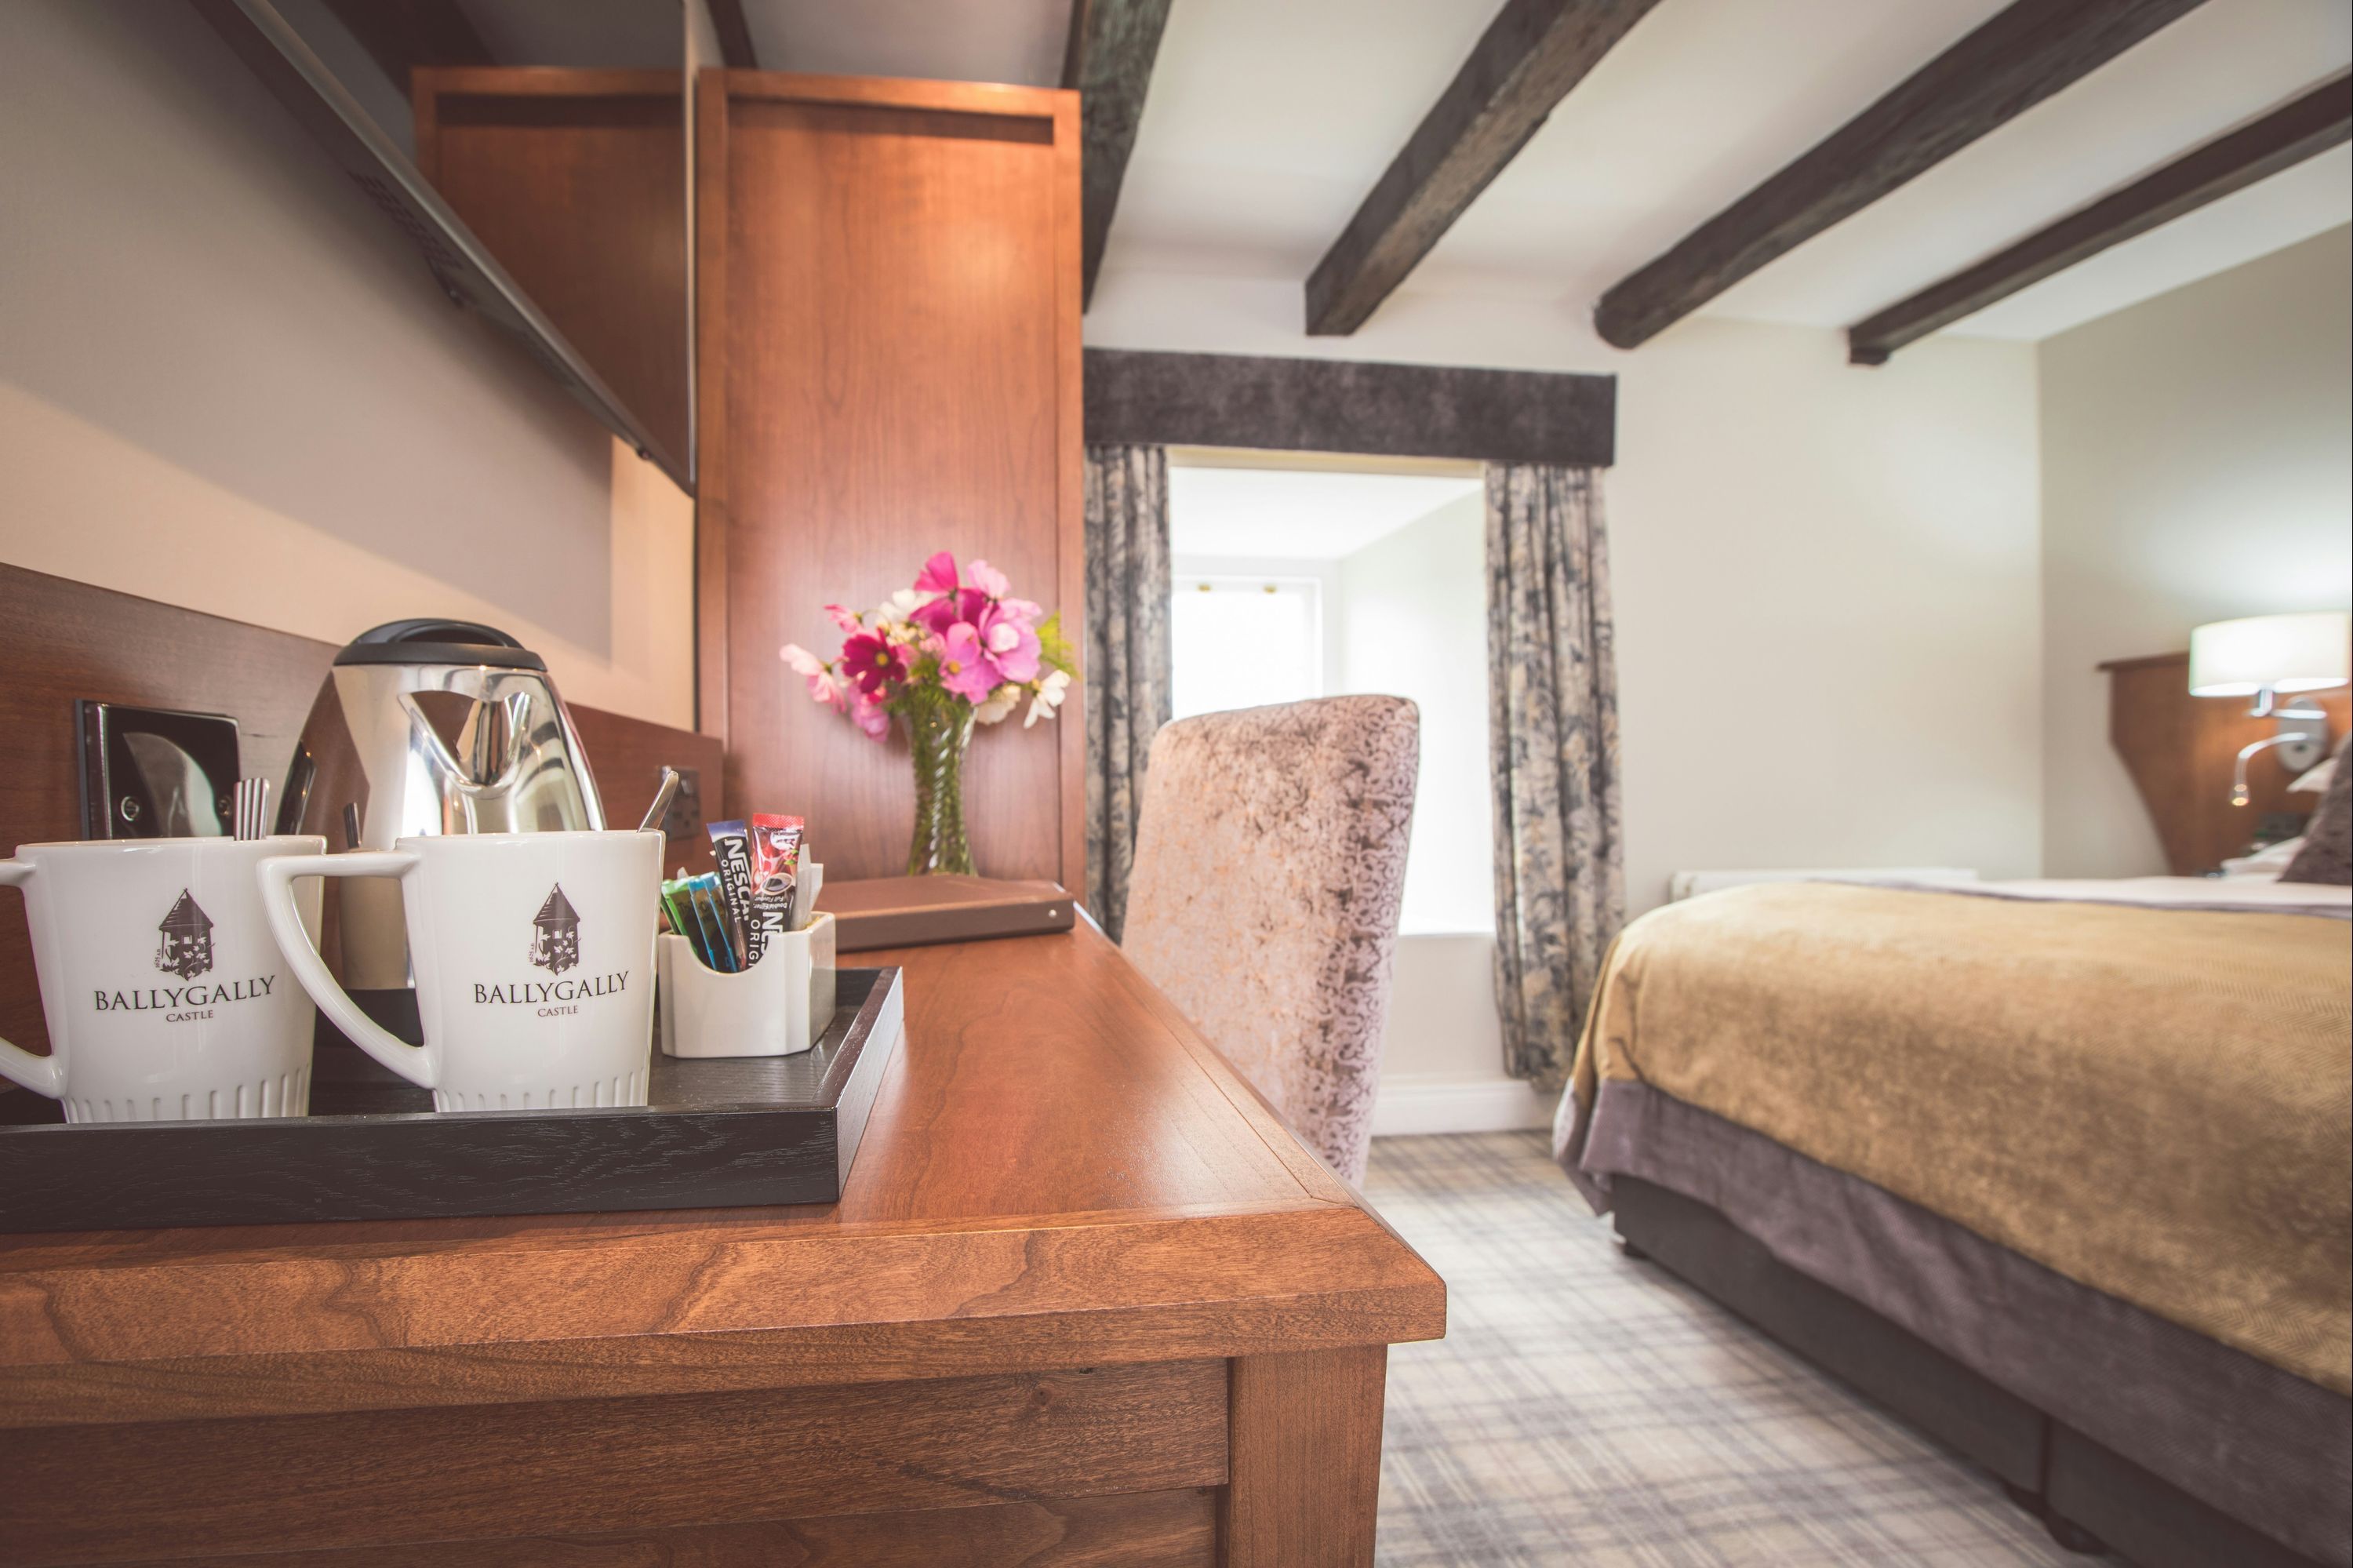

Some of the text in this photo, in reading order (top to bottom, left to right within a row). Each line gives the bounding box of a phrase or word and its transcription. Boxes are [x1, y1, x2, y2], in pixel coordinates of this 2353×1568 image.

[721, 859, 741, 923] ORIGINAL
[723, 839, 751, 921] NESCA
[94, 975, 275, 1010] BALLYGALLY
[474, 970, 630, 1004] BALLYGALLY
[165, 1010, 214, 1023] CASTLE
[537, 1005, 579, 1017] CASTLE
